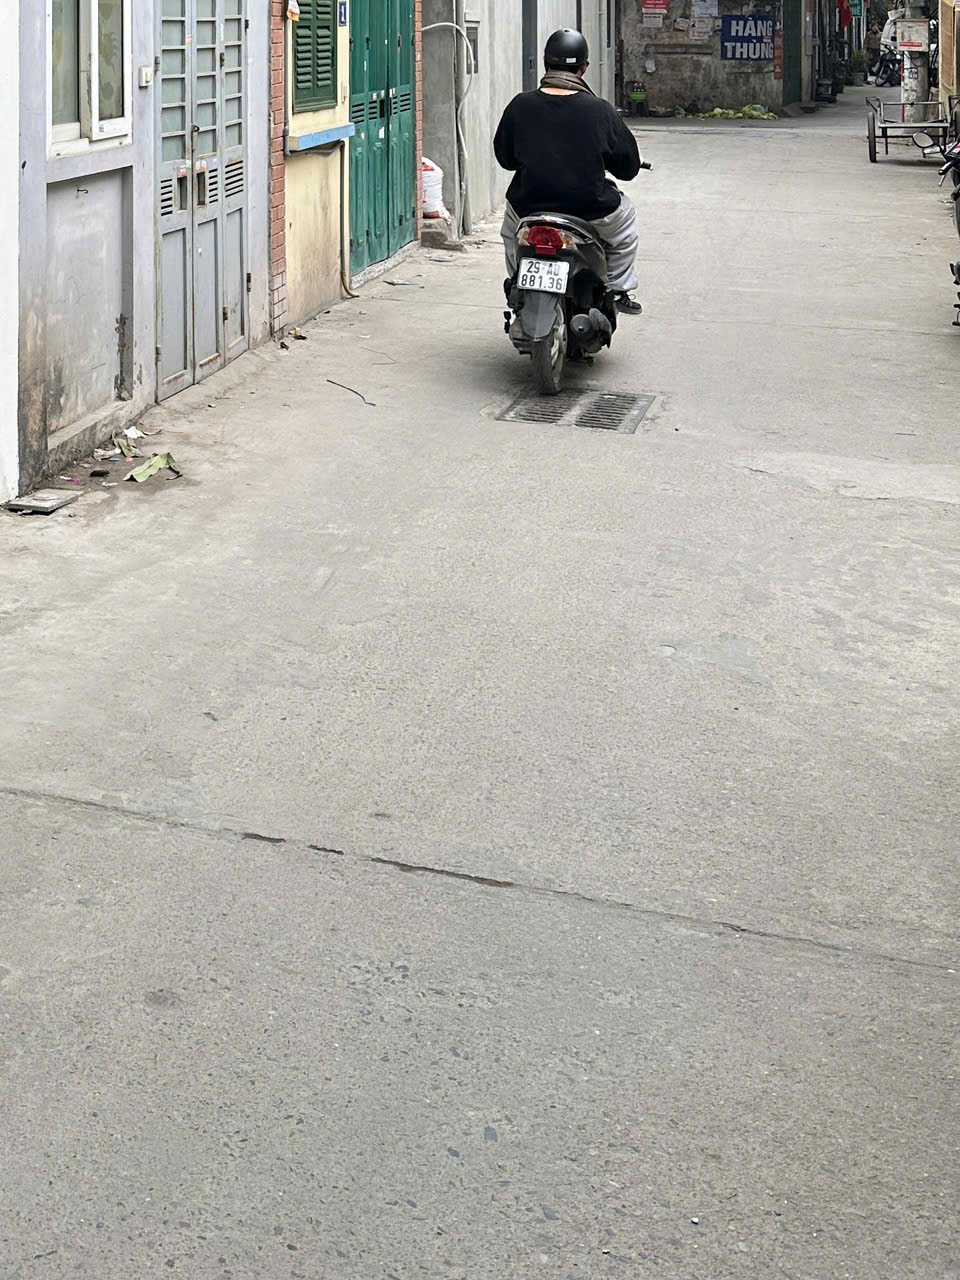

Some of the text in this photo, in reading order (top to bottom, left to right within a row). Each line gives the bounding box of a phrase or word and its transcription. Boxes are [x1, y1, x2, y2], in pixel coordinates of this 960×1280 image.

[730, 17, 773, 37] HÀNG
[724, 39, 774, 59] THÙNG
[521, 274, 562, 290] 881.36
